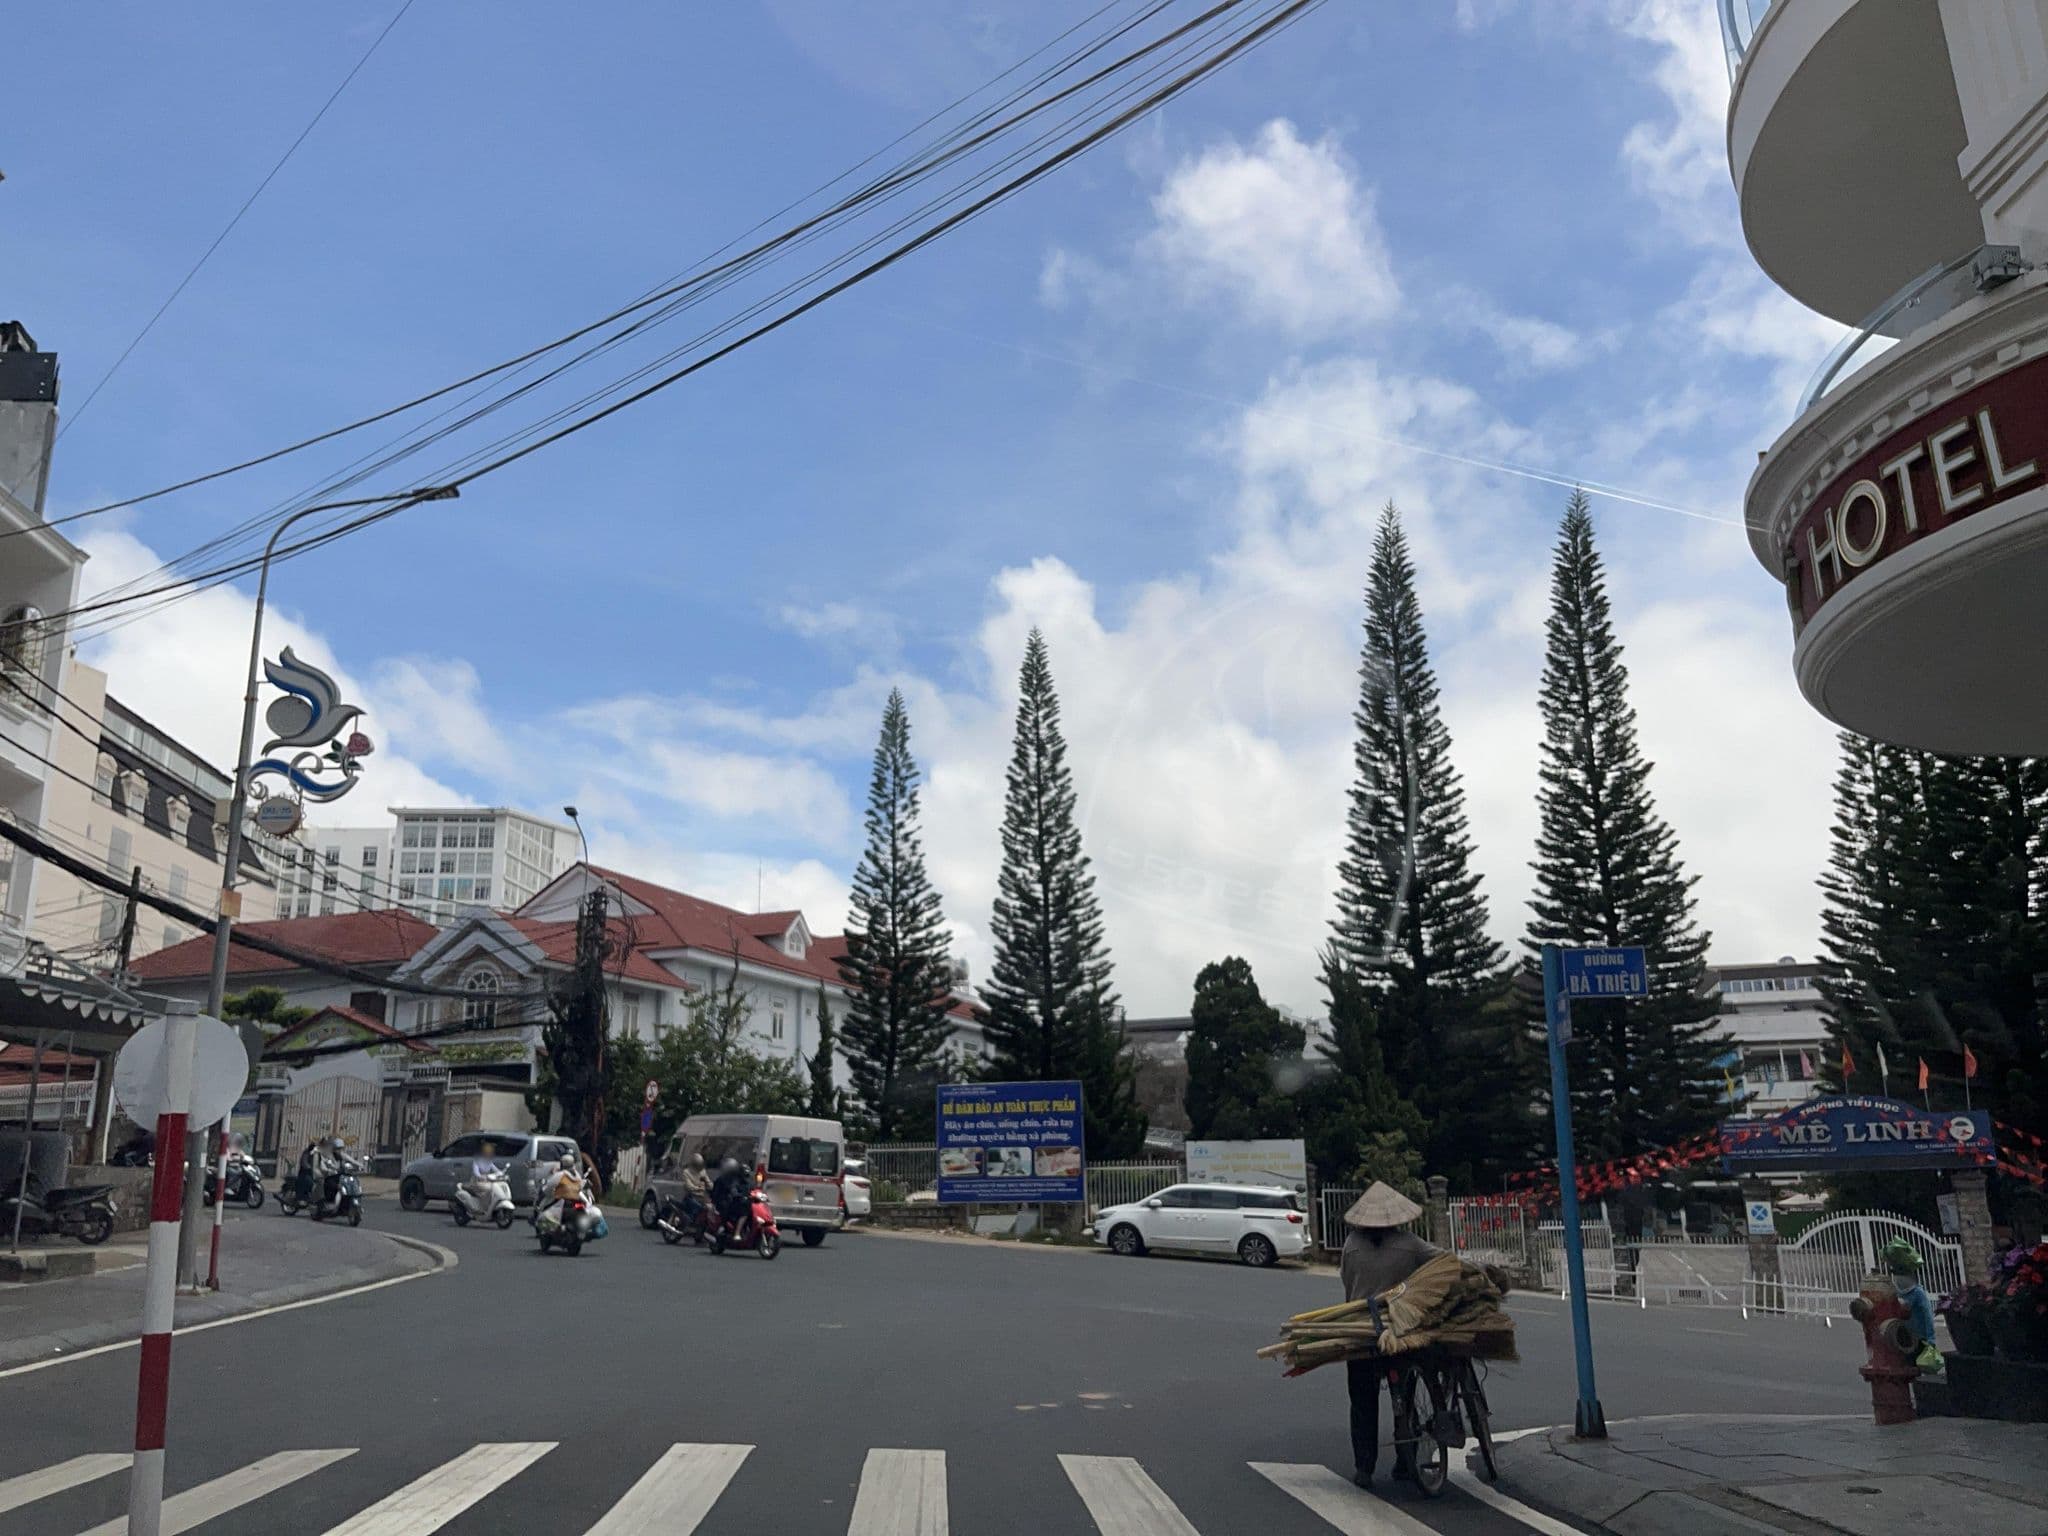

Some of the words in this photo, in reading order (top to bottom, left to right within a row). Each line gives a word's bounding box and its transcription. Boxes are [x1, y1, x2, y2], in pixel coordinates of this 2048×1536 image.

[1806, 404, 2038, 601] HOTEL
[1583, 949, 1625, 967] ĐƯỜNG
[1570, 970, 1590, 993] BÀ
[1595, 970, 1641, 993] TRIỆU
[993, 1102, 1004, 1114] AN
[1052, 1094, 1076, 1112] PHẨM
[1799, 1099, 1844, 1116] TRƯỜNG
[1847, 1096, 1873, 1109] TIỂU
[1875, 1101, 1900, 1113] HỌC
[1060, 1118, 1074, 1128] tay
[1778, 1119, 1832, 1145] MÊ
[1844, 1120, 1933, 1143] LINH
[979, 1132, 1005, 1142] xuyên
[1029, 1131, 1039, 1140] xà
